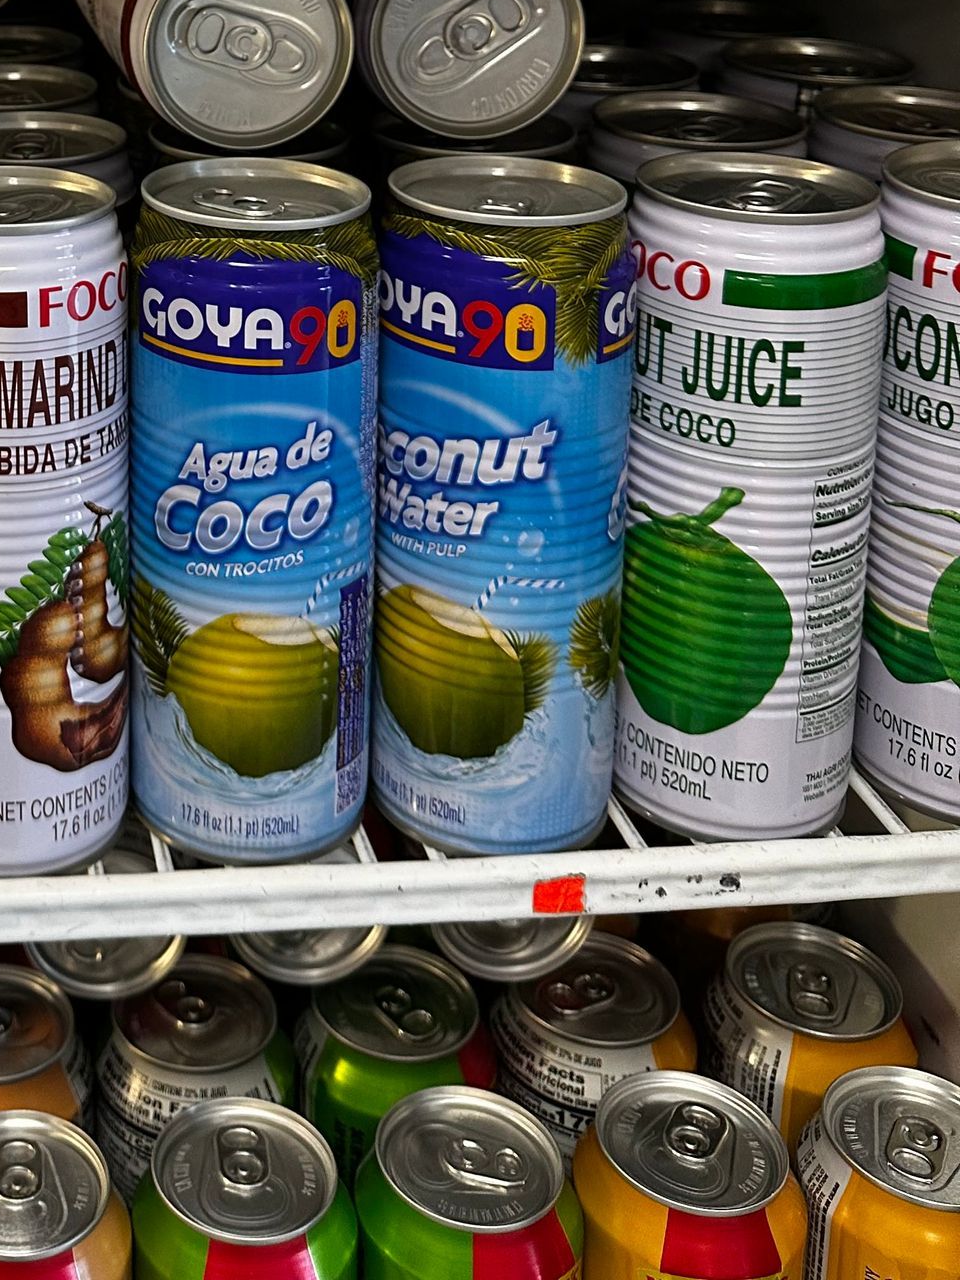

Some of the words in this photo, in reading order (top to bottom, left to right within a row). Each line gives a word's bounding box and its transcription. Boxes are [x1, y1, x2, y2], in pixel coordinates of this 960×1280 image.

[39, 261, 127, 328] FOCO
[142, 287, 285, 351] GOYA
[289, 299, 357, 366] 90
[462, 300, 547, 363] 90
[635, 308, 673, 385] UT
[681, 329, 805, 408] JUICE
[659, 402, 736, 448] COCO
[887, 383, 954, 430] JUGO
[65, 434, 91, 468] DE
[178, 442, 279, 494] Agua
[286, 422, 333, 471] de
[379, 418, 558, 487] conut
[378, 474, 499, 537] Water
[186, 561, 222, 578] CON
[224, 550, 305, 579] TROCITOS
[391, 532, 423, 554] WITH
[427, 542, 467, 558] PULP
[859, 690, 873, 712] ET
[872, 697, 957, 757] CONTENTS
[626, 723, 716, 776] CONTENIDO
[721, 760, 769, 784] NETO
[888, 737, 916, 767] 17.6
[920, 746, 930, 769] fl
[935, 759, 953, 780] oz
[30, 776, 107, 820] CONTENTS
[640, 758, 658, 783] pt)
[660, 772, 712, 800] 520mL
[51, 817, 80, 842] 17.6
[83, 813, 90, 831] fl
[93, 805, 105, 826] oz
[525, 1063, 585, 1096] Nutricional
[539, 1057, 585, 1084] Facts
